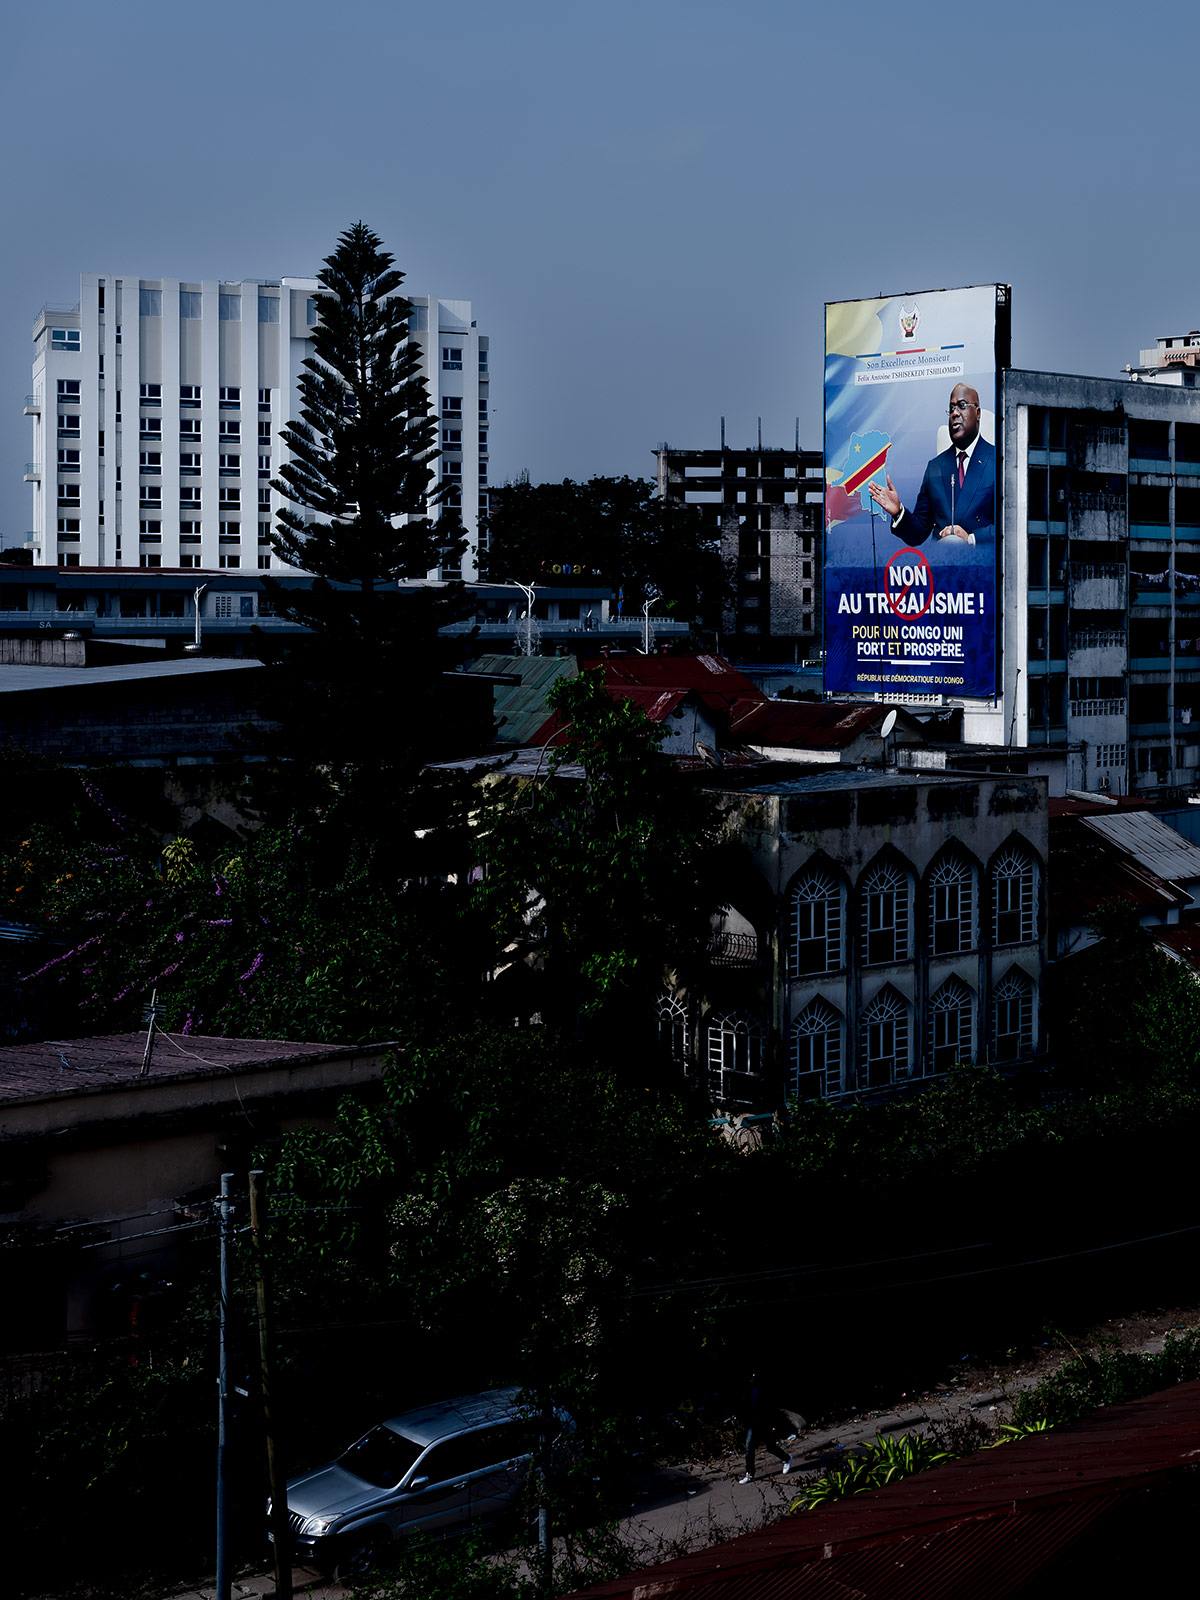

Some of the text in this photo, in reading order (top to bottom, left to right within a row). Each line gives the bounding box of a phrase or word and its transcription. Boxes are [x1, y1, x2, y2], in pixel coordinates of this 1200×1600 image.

[866, 354, 950, 369] Son Excellence Monsieur
[870, 373, 891, 381] Antoine
[891, 369, 925, 379] TSHISEKEDI
[926, 366, 961, 376] TSHILOMBO
[889, 565, 928, 586] NON
[837, 592, 985, 614] AU TRIBALISME !
[39, 621, 52, 629] SA
[852, 625, 963, 640] POUR UN CONGO UNI
[857, 640, 965, 657] FORT ET PROSPÈRE.
[891, 673, 934, 684] DÉMOCRATIQUE
[934, 676, 943, 684] DU
[943, 676, 965, 685] CONGO
